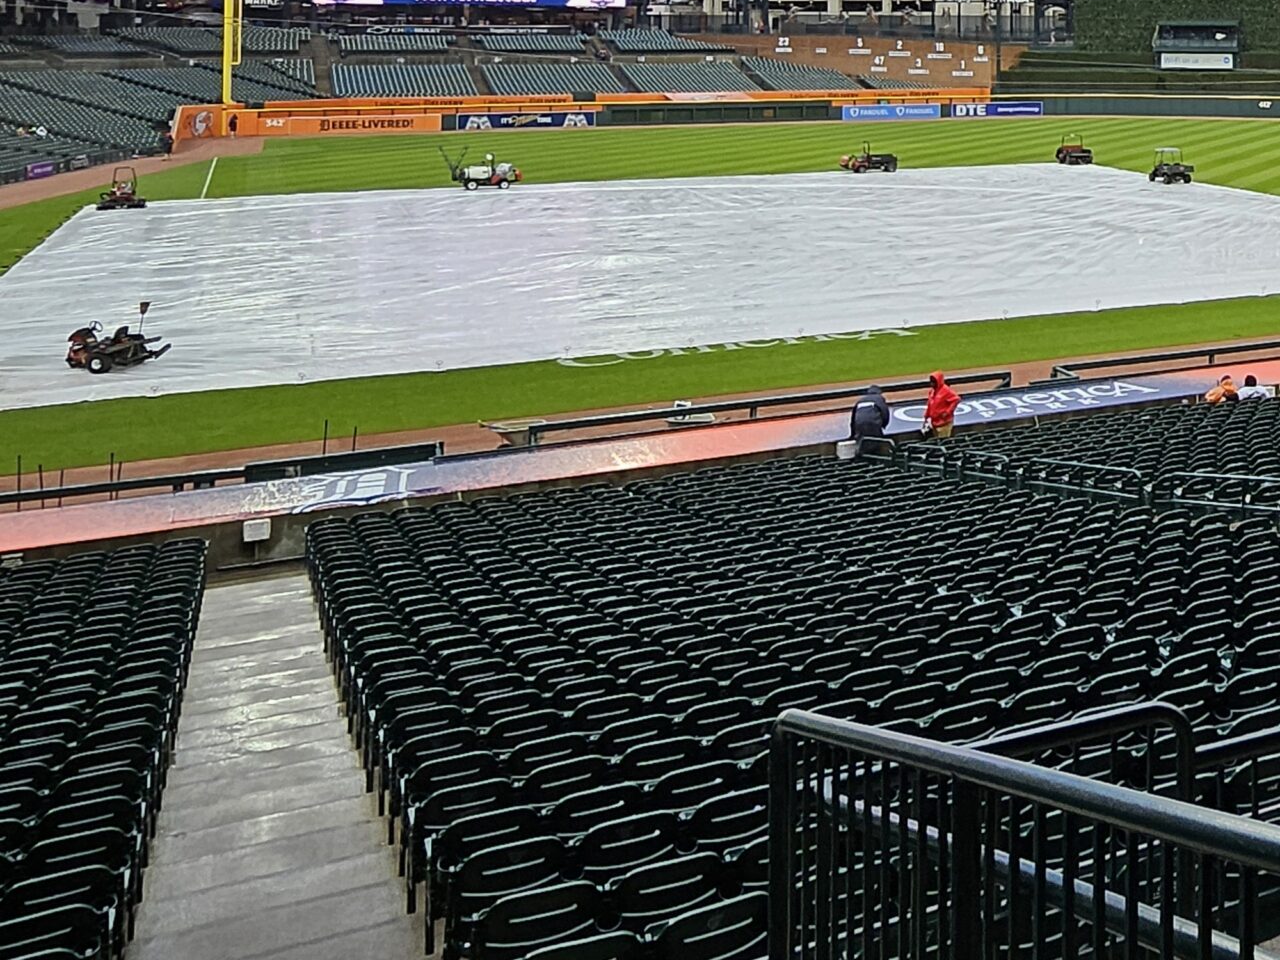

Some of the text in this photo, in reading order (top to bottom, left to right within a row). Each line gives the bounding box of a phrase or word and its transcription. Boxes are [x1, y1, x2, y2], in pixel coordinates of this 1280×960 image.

[778, 37, 789, 46] 23
[874, 56, 885, 65] 47
[955, 104, 987, 116] DTE
[980, 396, 1100, 418] PARK
